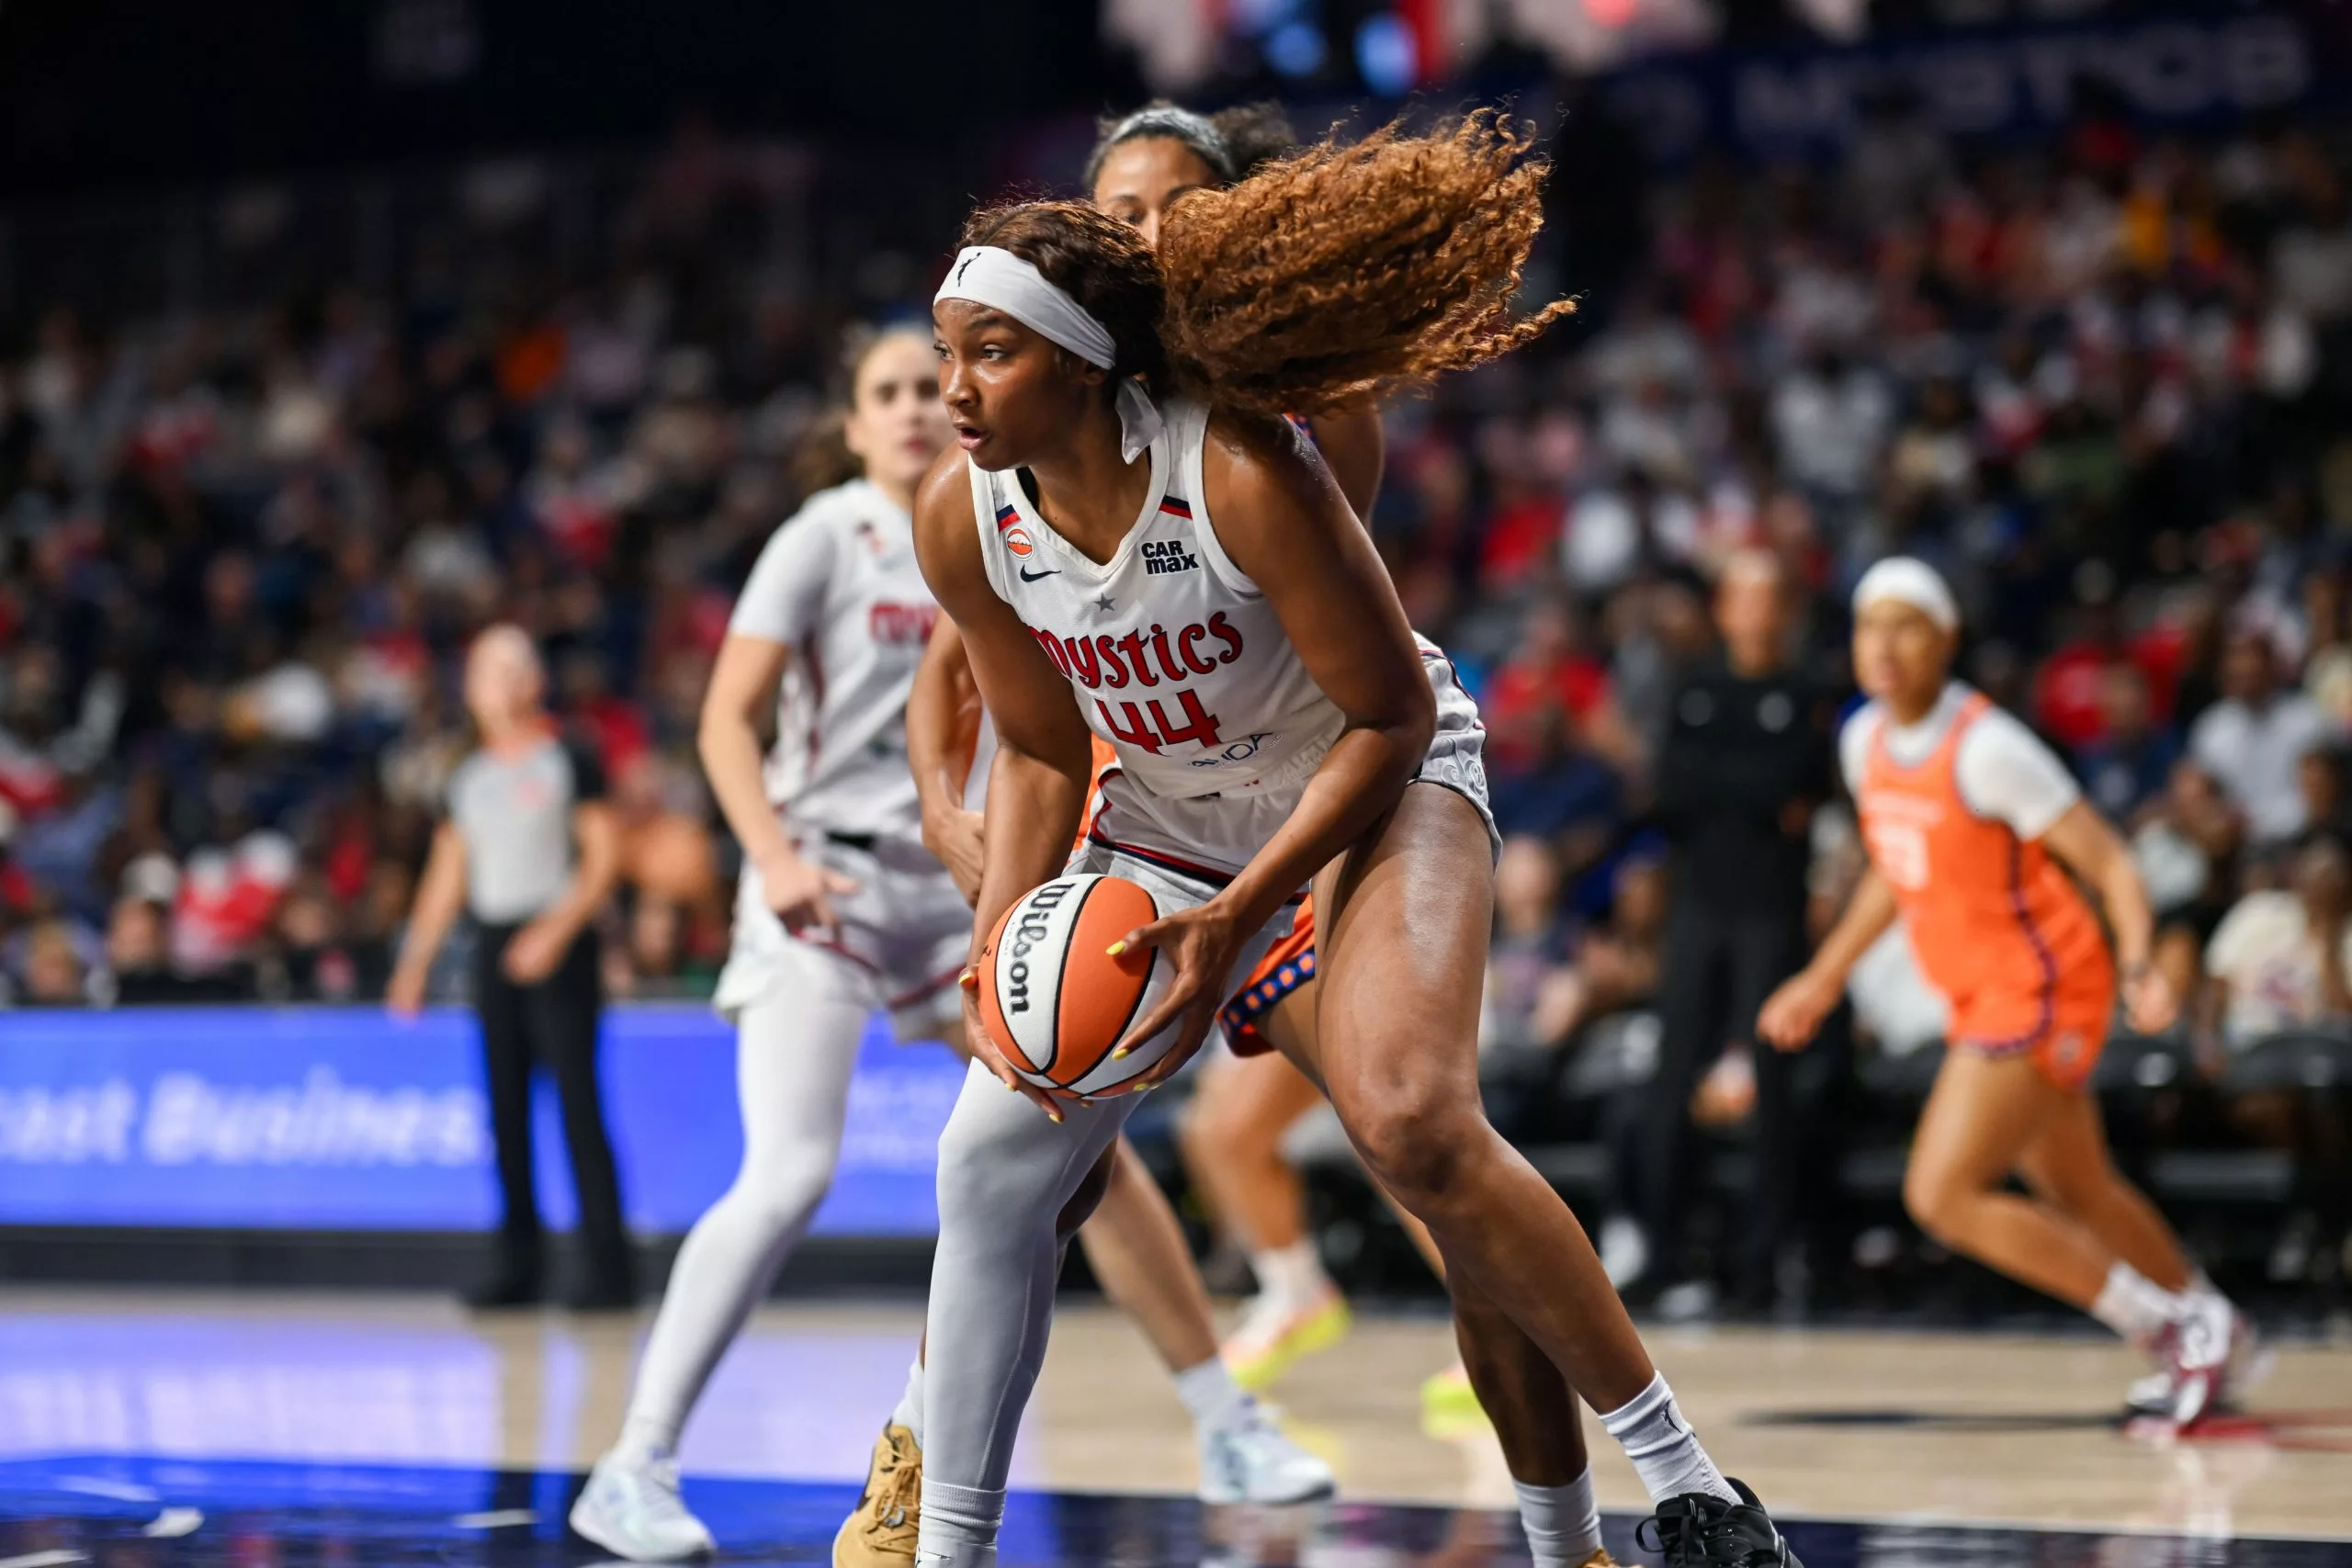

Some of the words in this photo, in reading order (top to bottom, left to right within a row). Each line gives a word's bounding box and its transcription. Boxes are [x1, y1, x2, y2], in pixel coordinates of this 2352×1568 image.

[1141, 540, 1184, 558] CAR
[1145, 553, 1200, 575] max
[1094, 688, 1223, 758] 44
[1009, 883, 1076, 1015] Wilson
[143, 1062, 491, 1167] Busines
